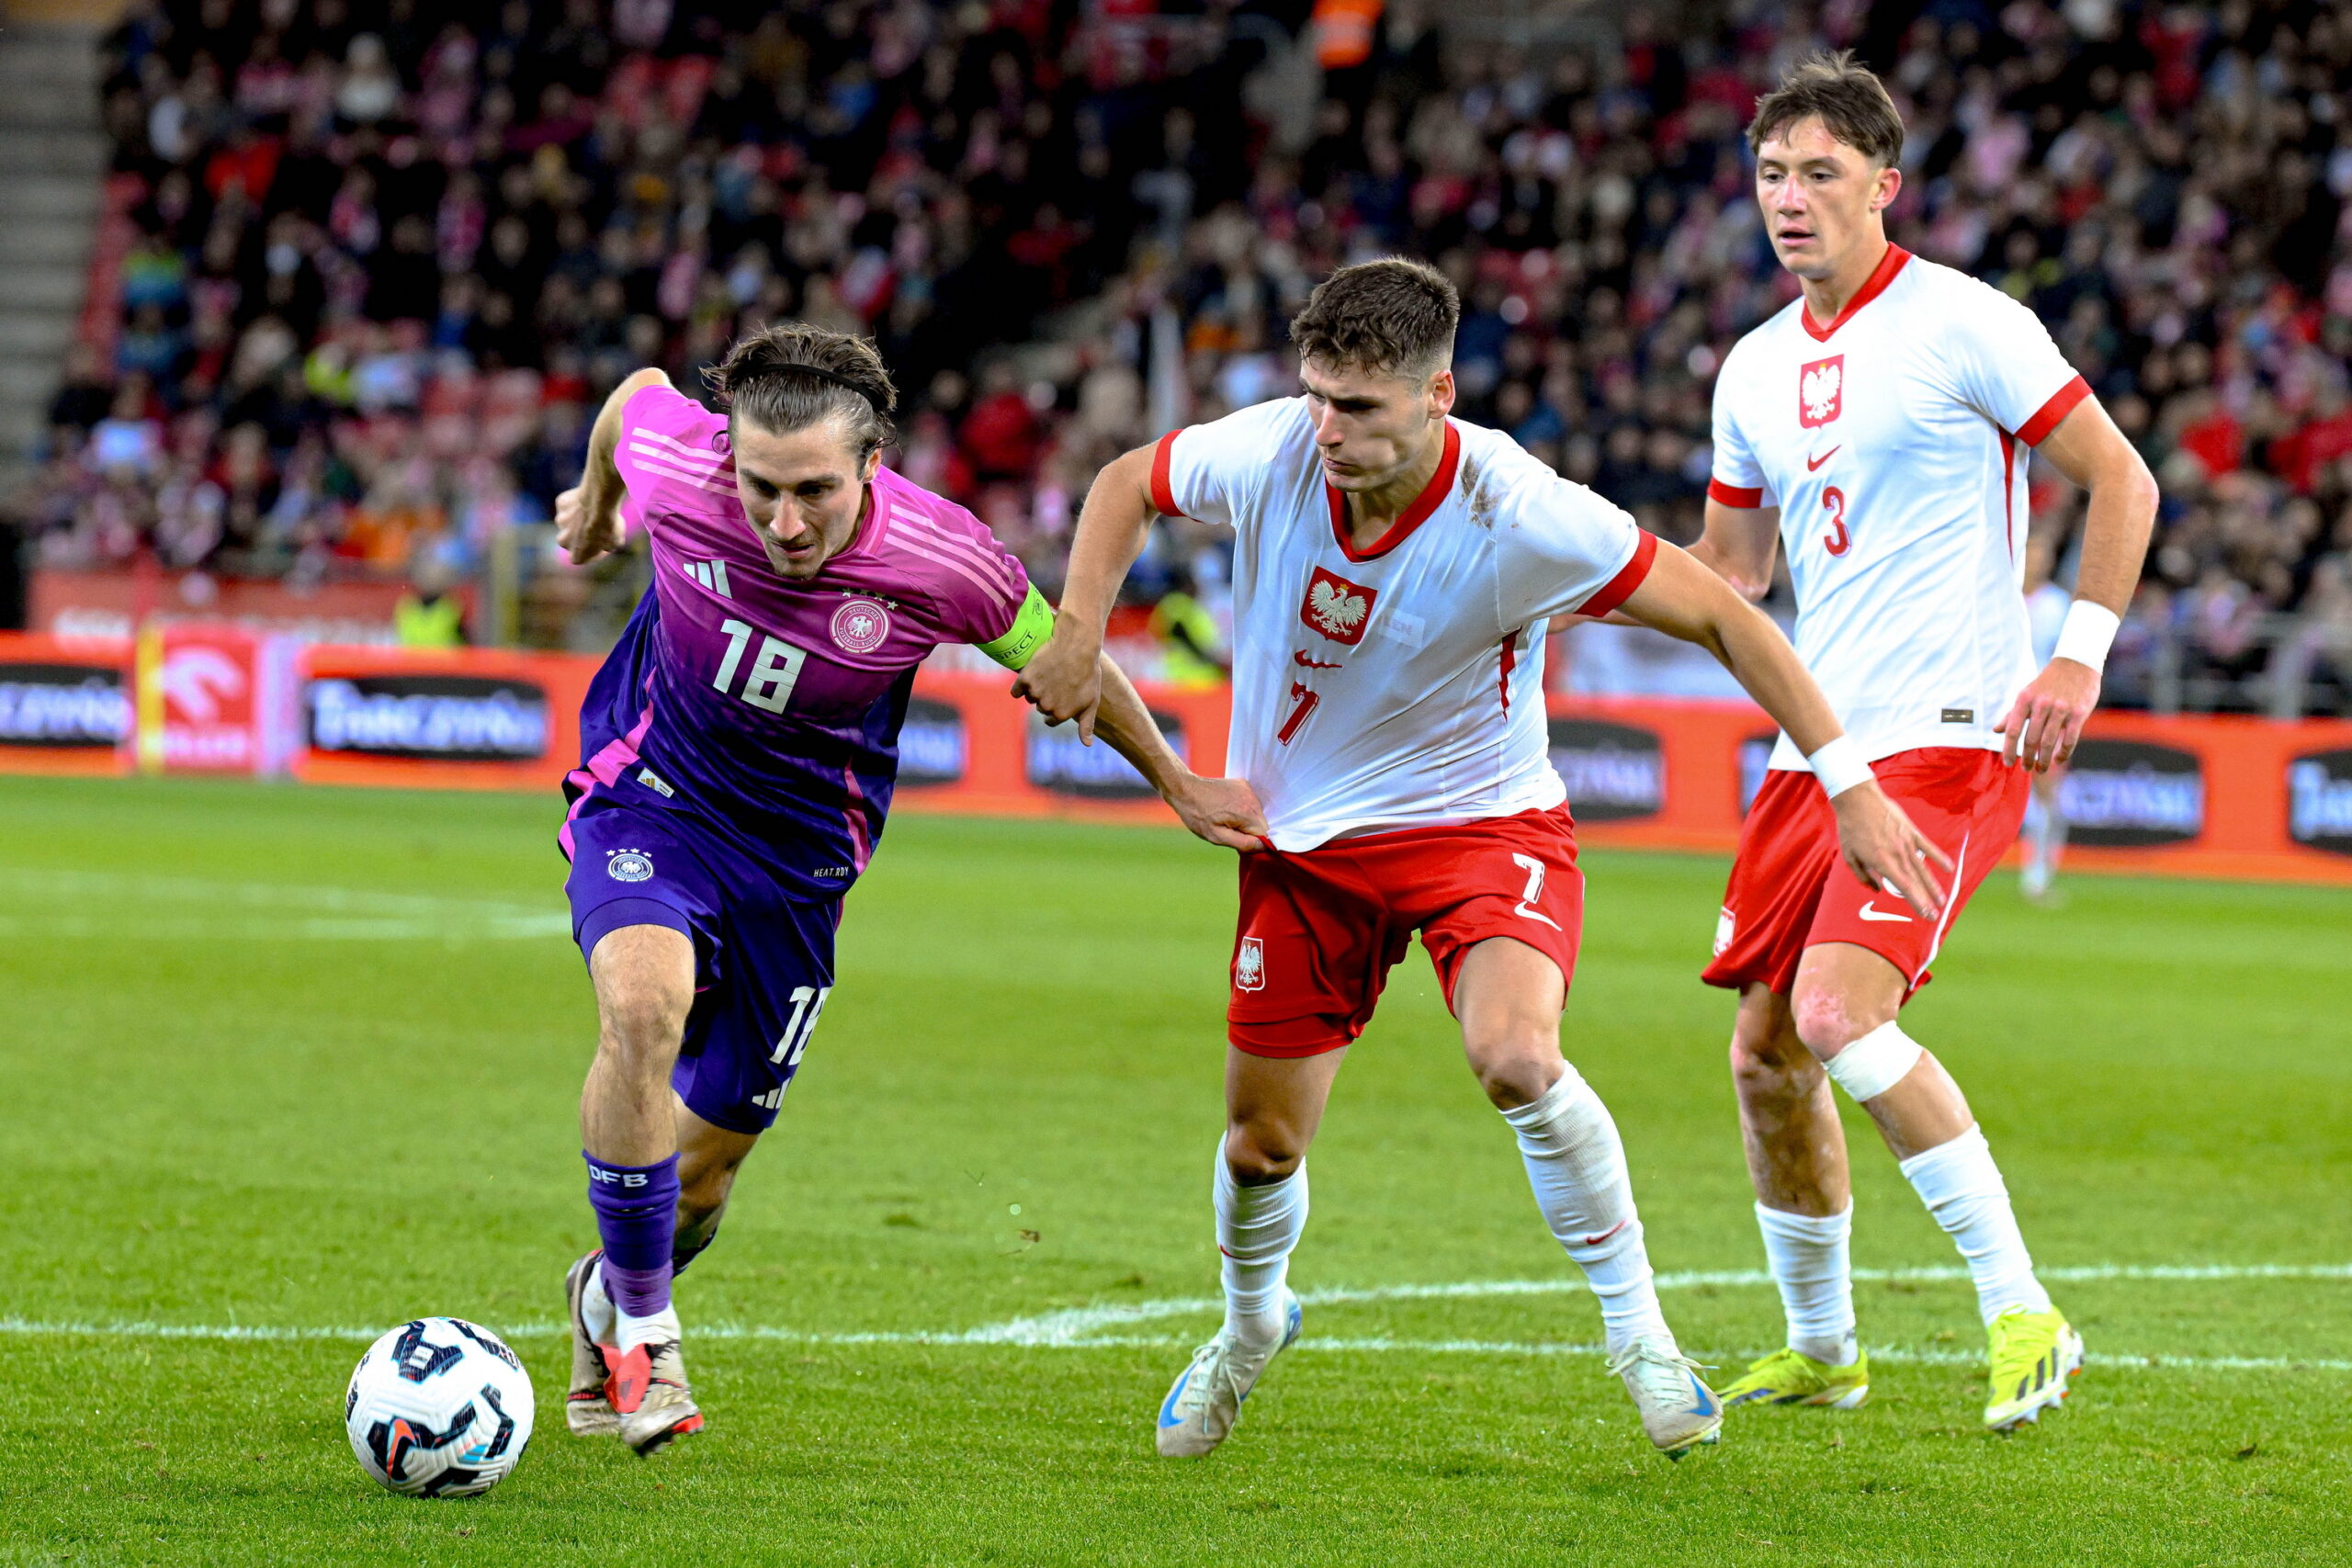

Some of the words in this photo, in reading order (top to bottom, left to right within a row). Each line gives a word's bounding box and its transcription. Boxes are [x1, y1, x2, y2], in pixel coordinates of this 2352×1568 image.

[1823, 486, 1852, 558] 3
[713, 618, 808, 715] 18
[1277, 681, 1320, 747] 7
[813, 866, 849, 877] HEAT.RDY
[1511, 852, 1545, 905] 7
[588, 1164, 649, 1188] DFB
